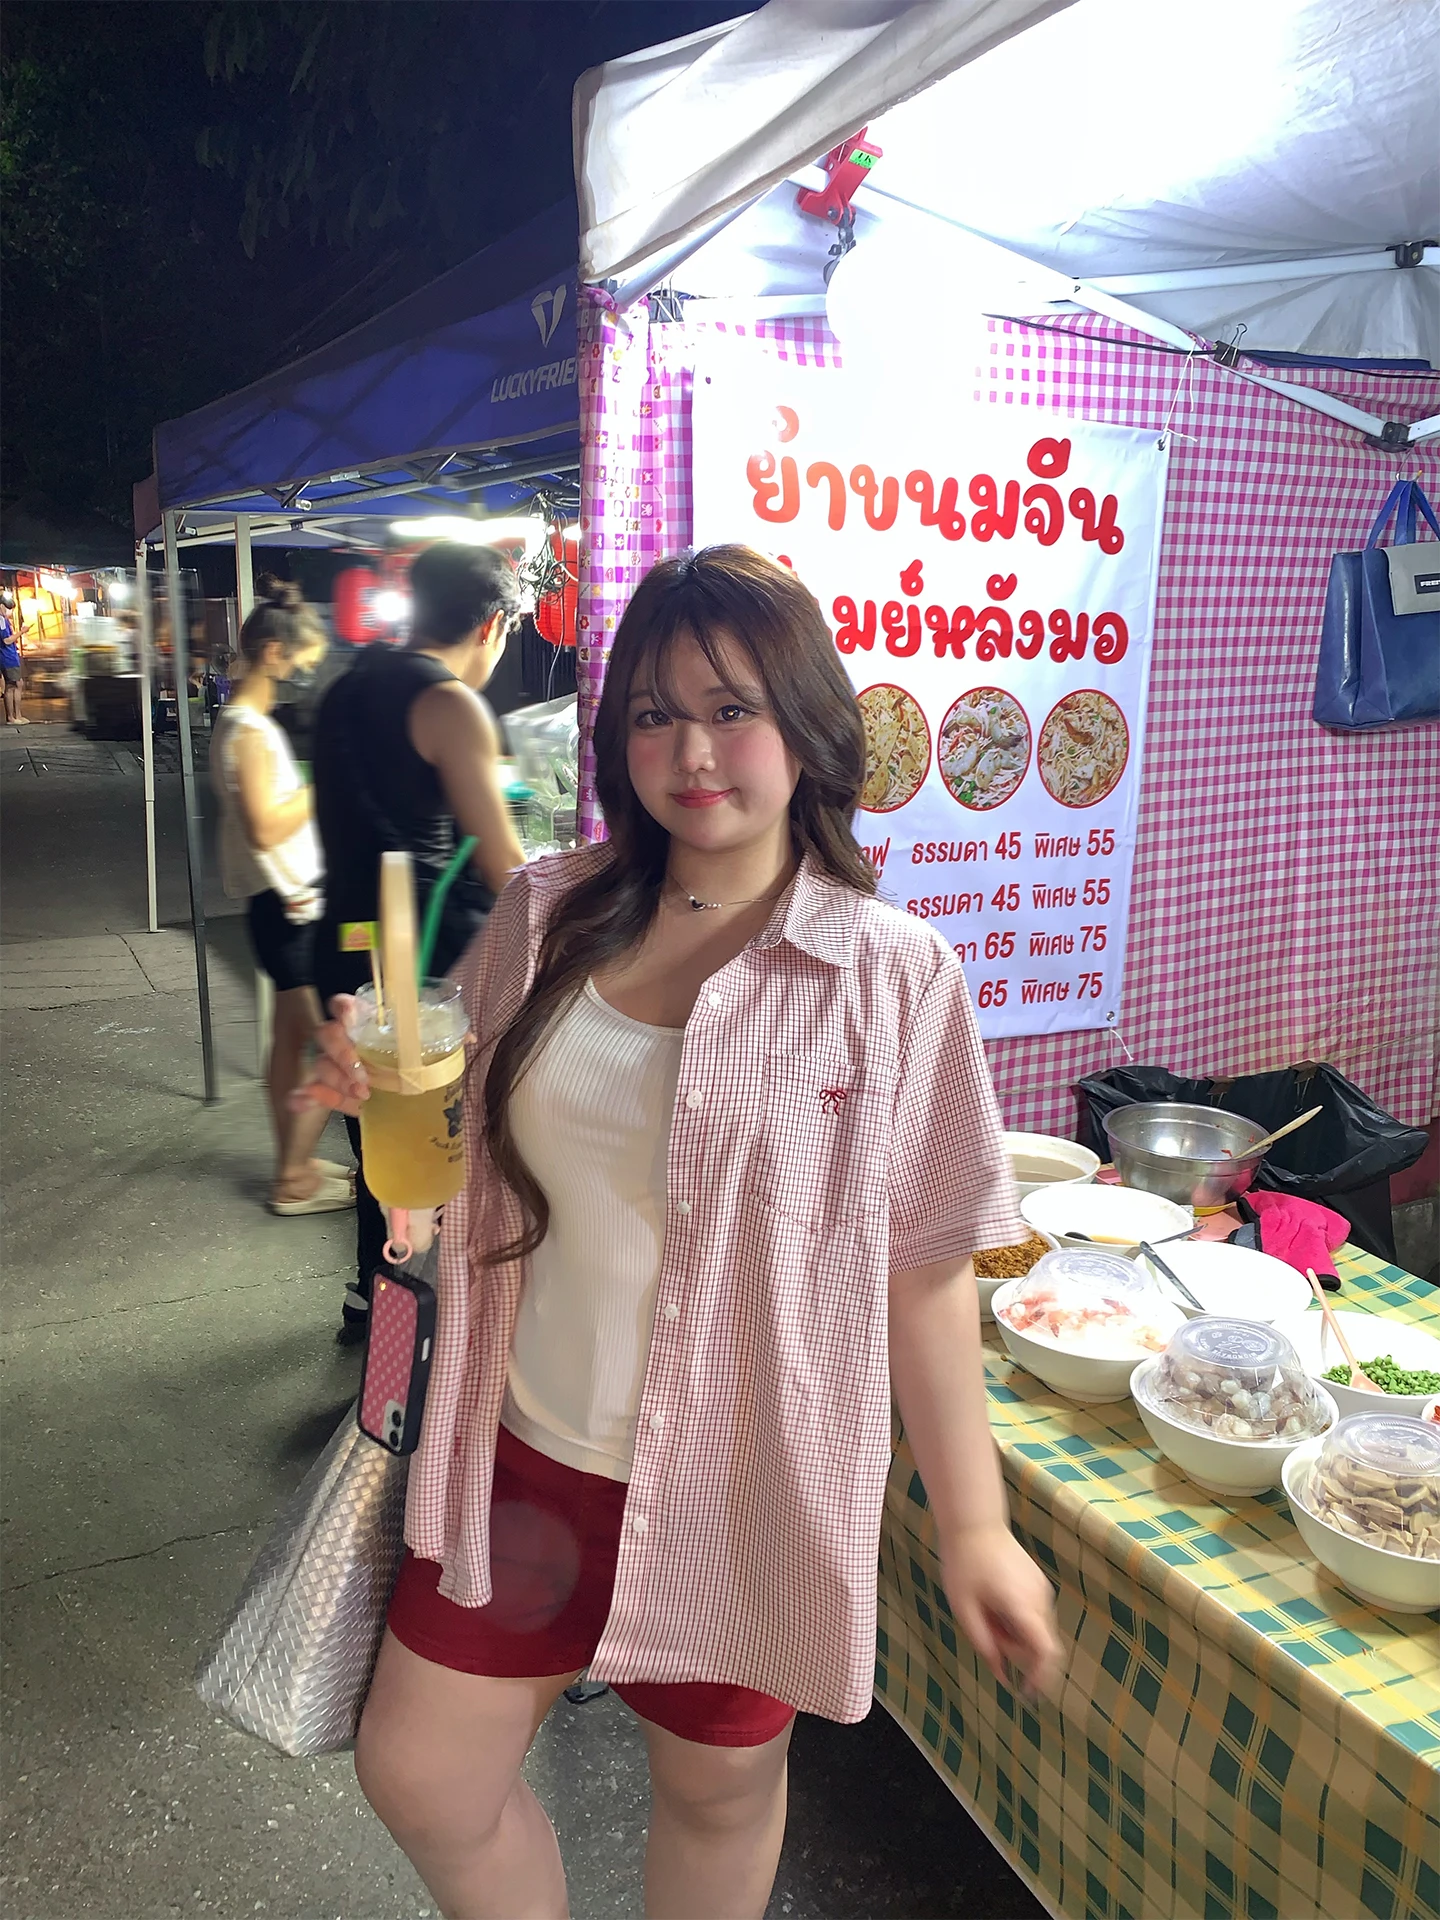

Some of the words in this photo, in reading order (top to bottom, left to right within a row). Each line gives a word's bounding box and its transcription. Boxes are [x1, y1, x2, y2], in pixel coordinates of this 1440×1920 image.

[745, 406, 1125, 556] ยำขนมจีน
[818, 559, 1129, 665] มย์หลังมอ
[911, 840, 988, 865] ธรรมดา
[995, 832, 1022, 860] 45
[1035, 833, 1081, 858] พิเศษ
[1087, 829, 1115, 856] 55
[907, 892, 983, 919] ธรรมดา
[991, 884, 1020, 912] 45
[1033, 884, 1077, 909] พิเศษ
[1082, 878, 1111, 906] 55
[985, 931, 1016, 960] 65
[1030, 932, 1075, 957] พิเศษ
[1080, 925, 1108, 951] 75
[978, 979, 1008, 1009] 65
[1021, 979, 1069, 1004] พิเศษ
[1077, 972, 1104, 999] 75
